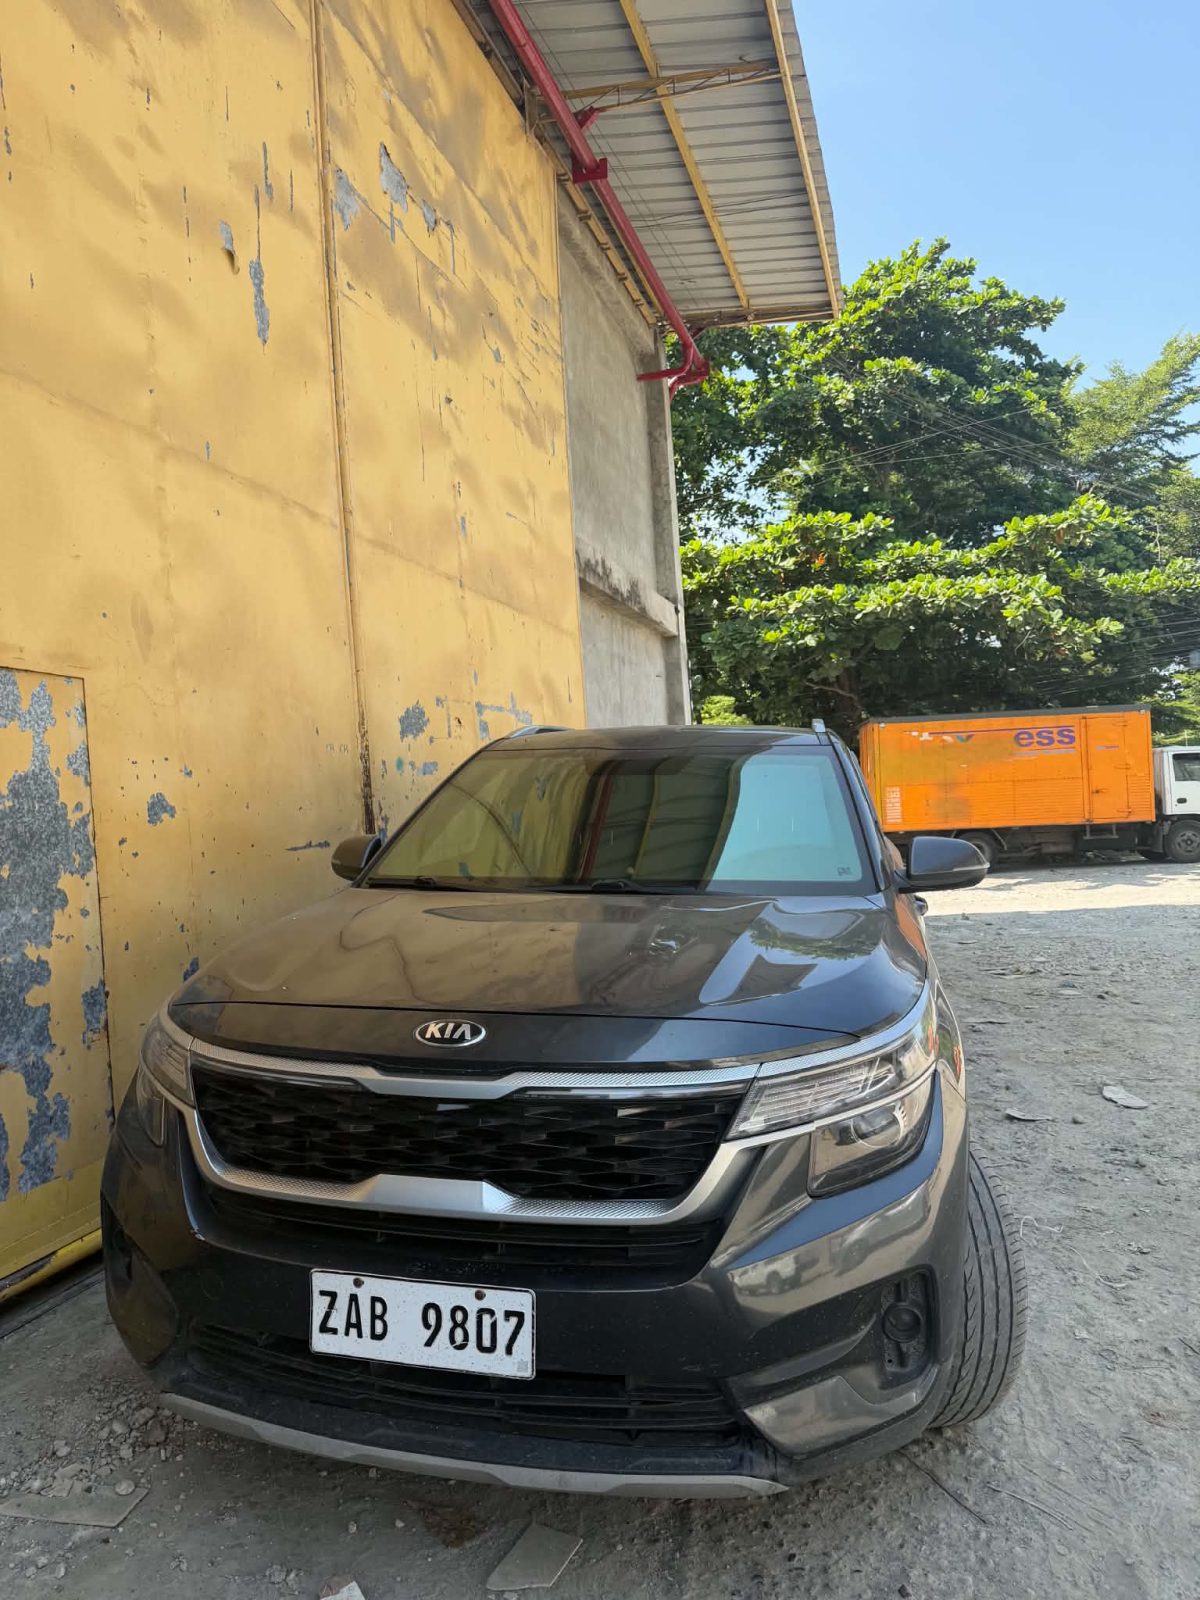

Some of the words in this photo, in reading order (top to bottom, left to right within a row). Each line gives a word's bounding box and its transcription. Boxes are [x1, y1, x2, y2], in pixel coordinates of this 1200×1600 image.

[1014, 728, 1076, 747] ess
[425, 1022, 471, 1040] KIA
[318, 1289, 388, 1341] ZAB
[421, 1302, 525, 1356] 9807
